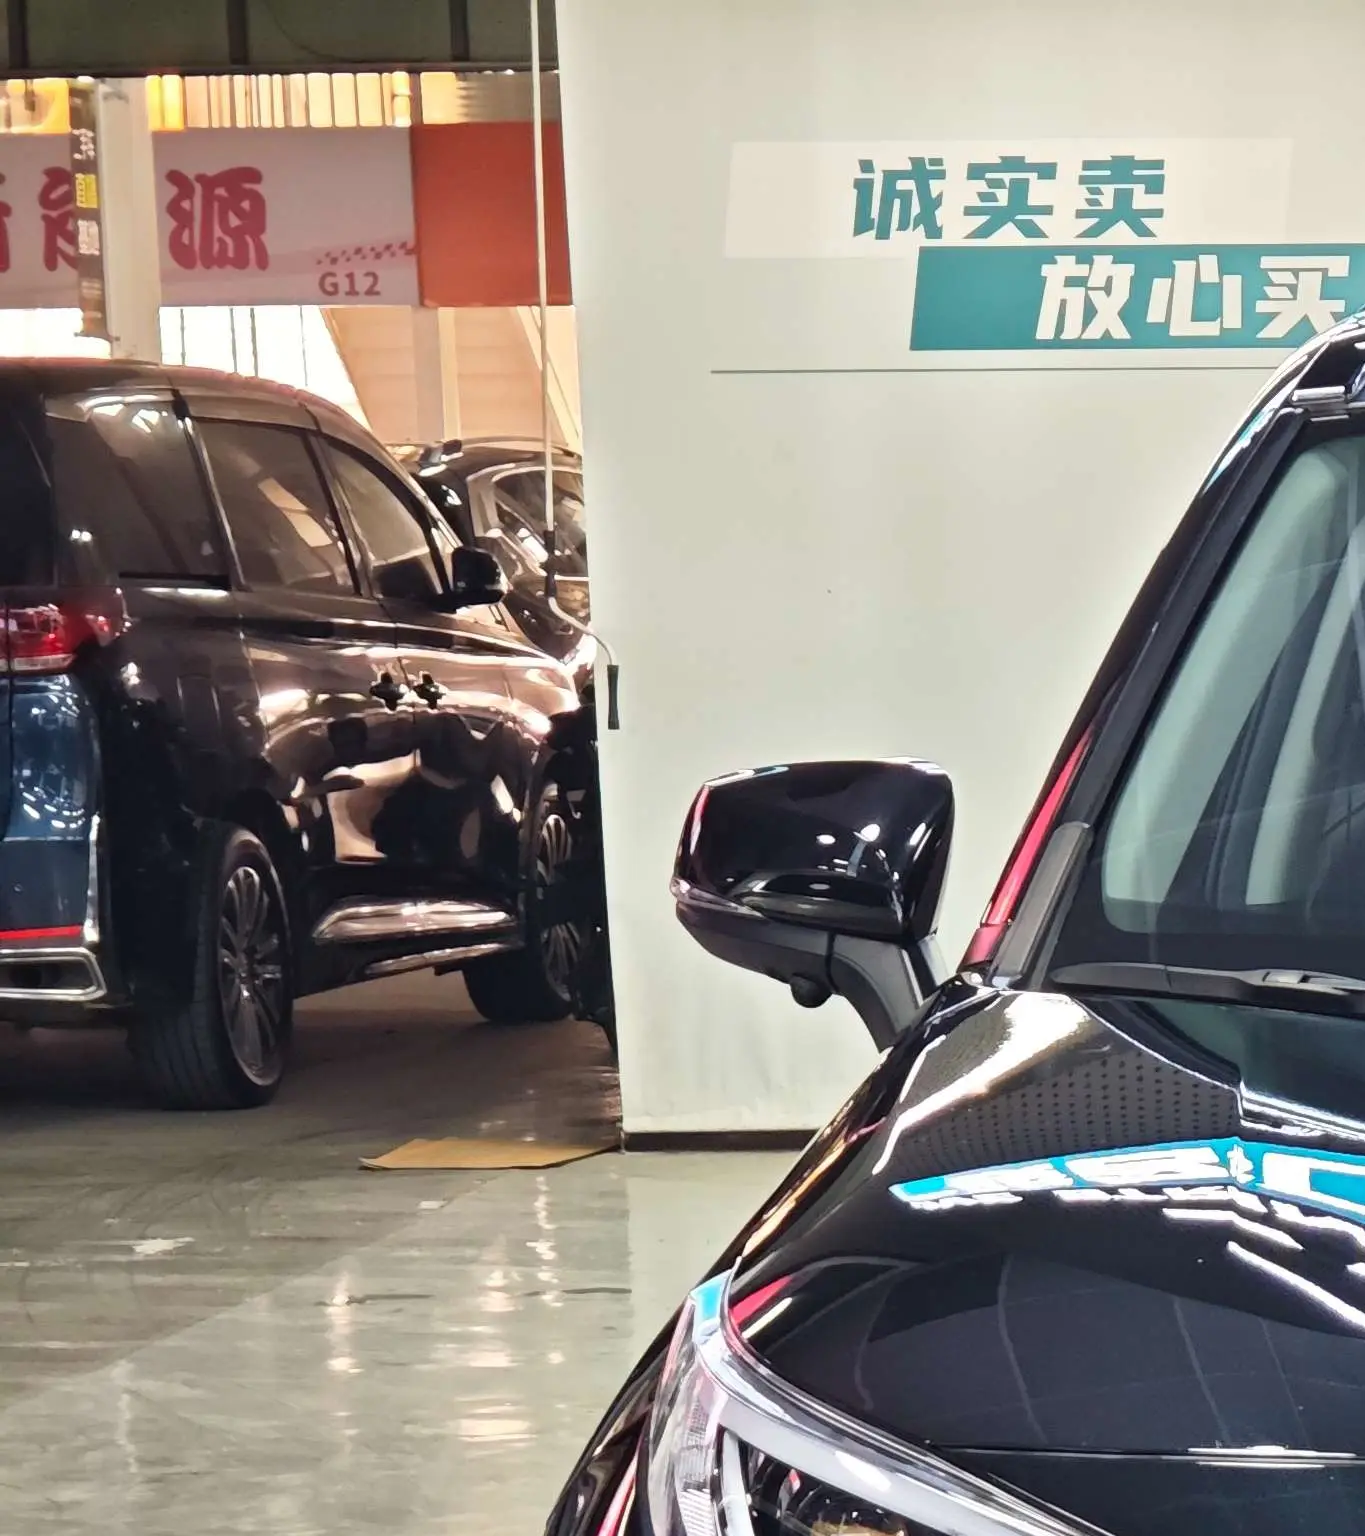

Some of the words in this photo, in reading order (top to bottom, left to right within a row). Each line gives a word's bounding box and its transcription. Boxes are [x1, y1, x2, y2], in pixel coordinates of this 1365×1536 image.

[853, 155, 1167, 240] 诚实卖
[317, 271, 382, 298] G12
[1034, 253, 1351, 341] 放心买
